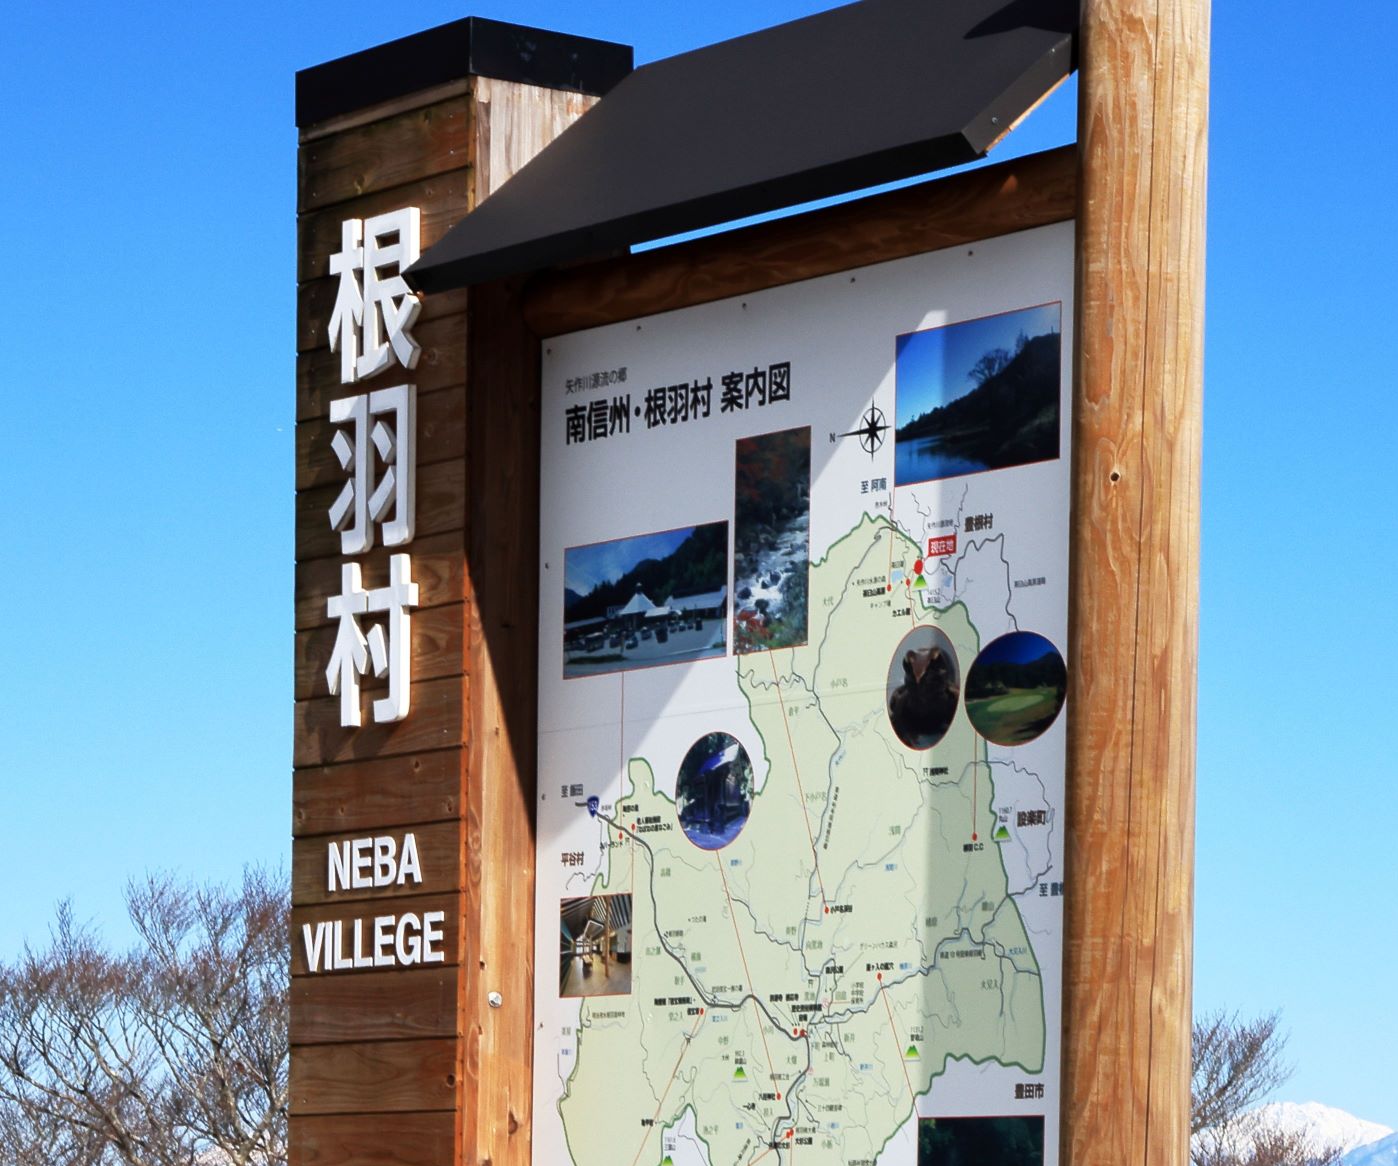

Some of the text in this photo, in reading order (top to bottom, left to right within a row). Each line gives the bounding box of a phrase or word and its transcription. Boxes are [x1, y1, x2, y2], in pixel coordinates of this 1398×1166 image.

[565, 366, 627, 395] 矢作川源流の郷
[720, 361, 791, 413] 案内図
[326, 206, 422, 728] 根羽村
[861, 481, 869, 494] 至
[964, 512, 993, 532] 豊根村
[930, 538, 955, 555] 現在地
[561, 785, 568, 798] 至
[1016, 809, 1047, 828] 設楽町
[327, 833, 422, 891] NEBA
[1039, 882, 1048, 897] 至
[302, 911, 444, 971] VILLEGE
[1014, 1083, 1045, 1100] 豊田市
